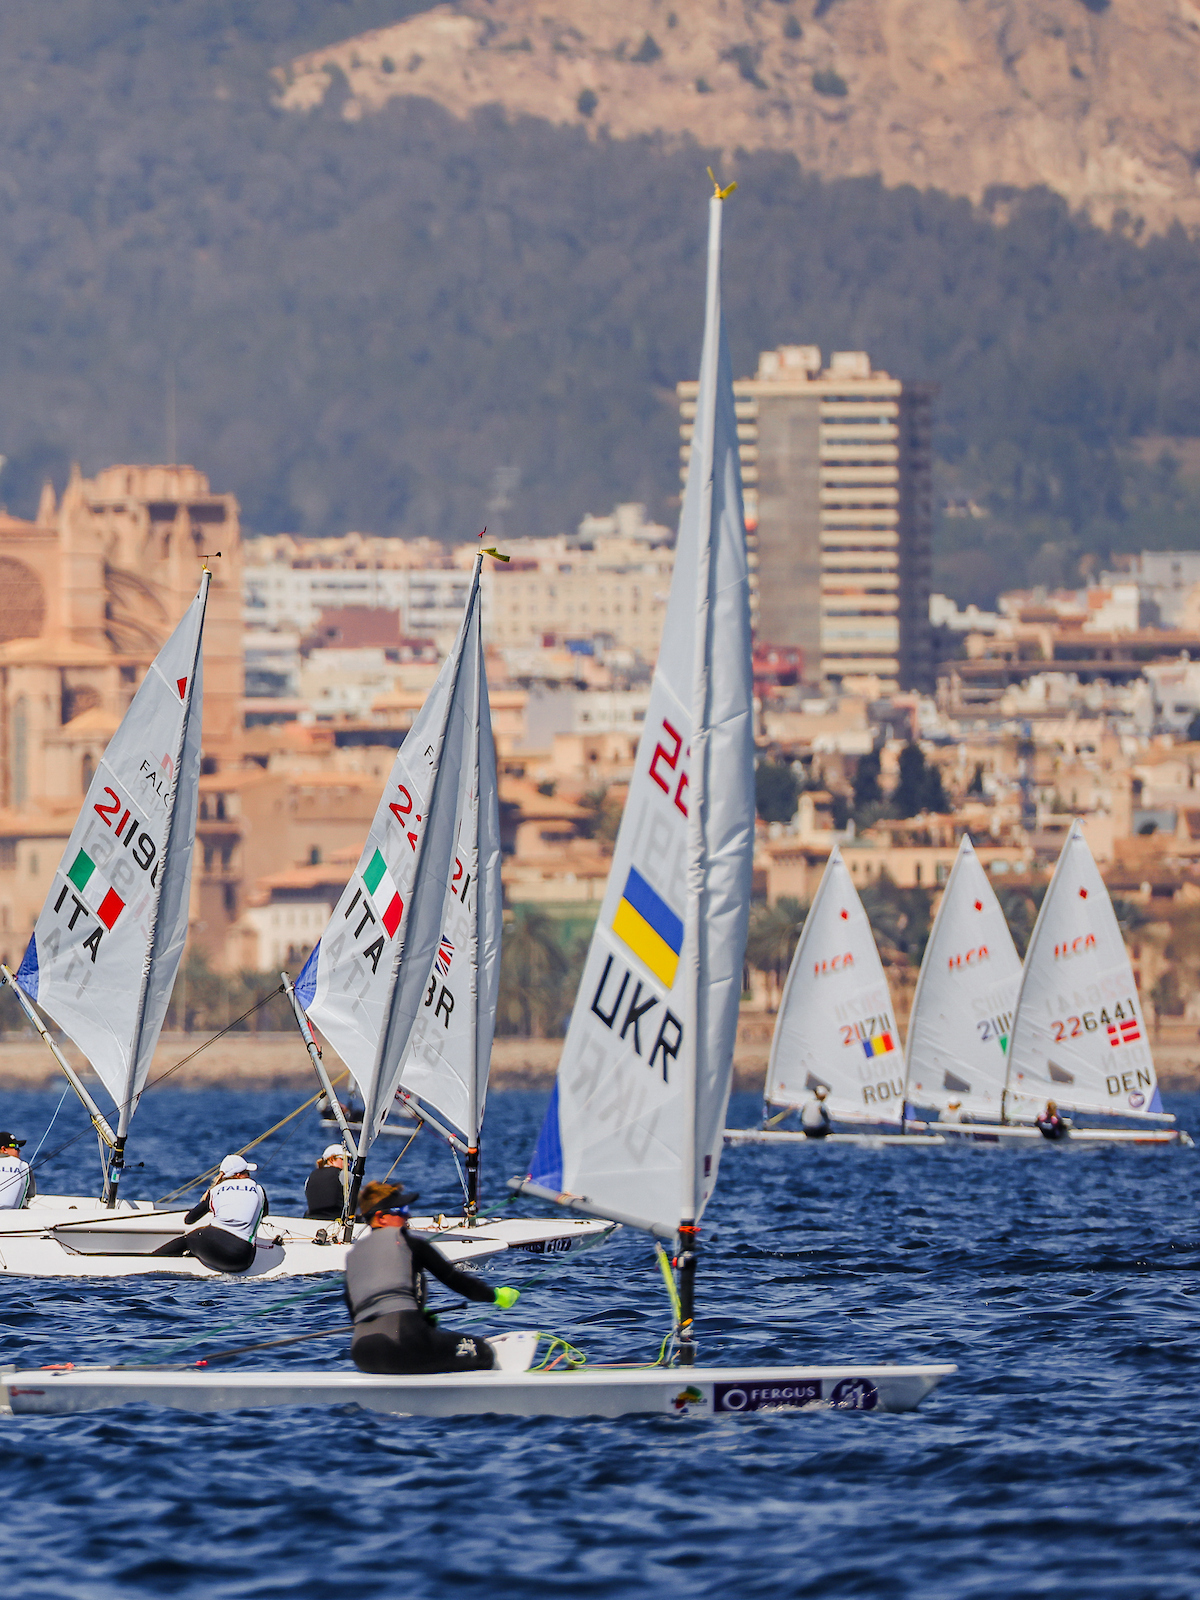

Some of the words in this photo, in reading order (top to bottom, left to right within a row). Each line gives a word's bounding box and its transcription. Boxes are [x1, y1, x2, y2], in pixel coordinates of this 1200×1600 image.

[93, 786, 160, 889] 2119
[53, 884, 104, 963] ITA
[344, 887, 385, 975] ITA
[948, 945, 989, 973] ILCA
[1054, 933, 1097, 962] ILCA
[814, 951, 855, 979] ILCA
[591, 953, 684, 1084] UKR
[839, 1012, 892, 1046] 211711
[1050, 997, 1137, 1044] 226441
[862, 1077, 904, 1105] ROU
[1105, 1067, 1152, 1097] DEN
[751, 1385, 817, 1401] FERGUS
